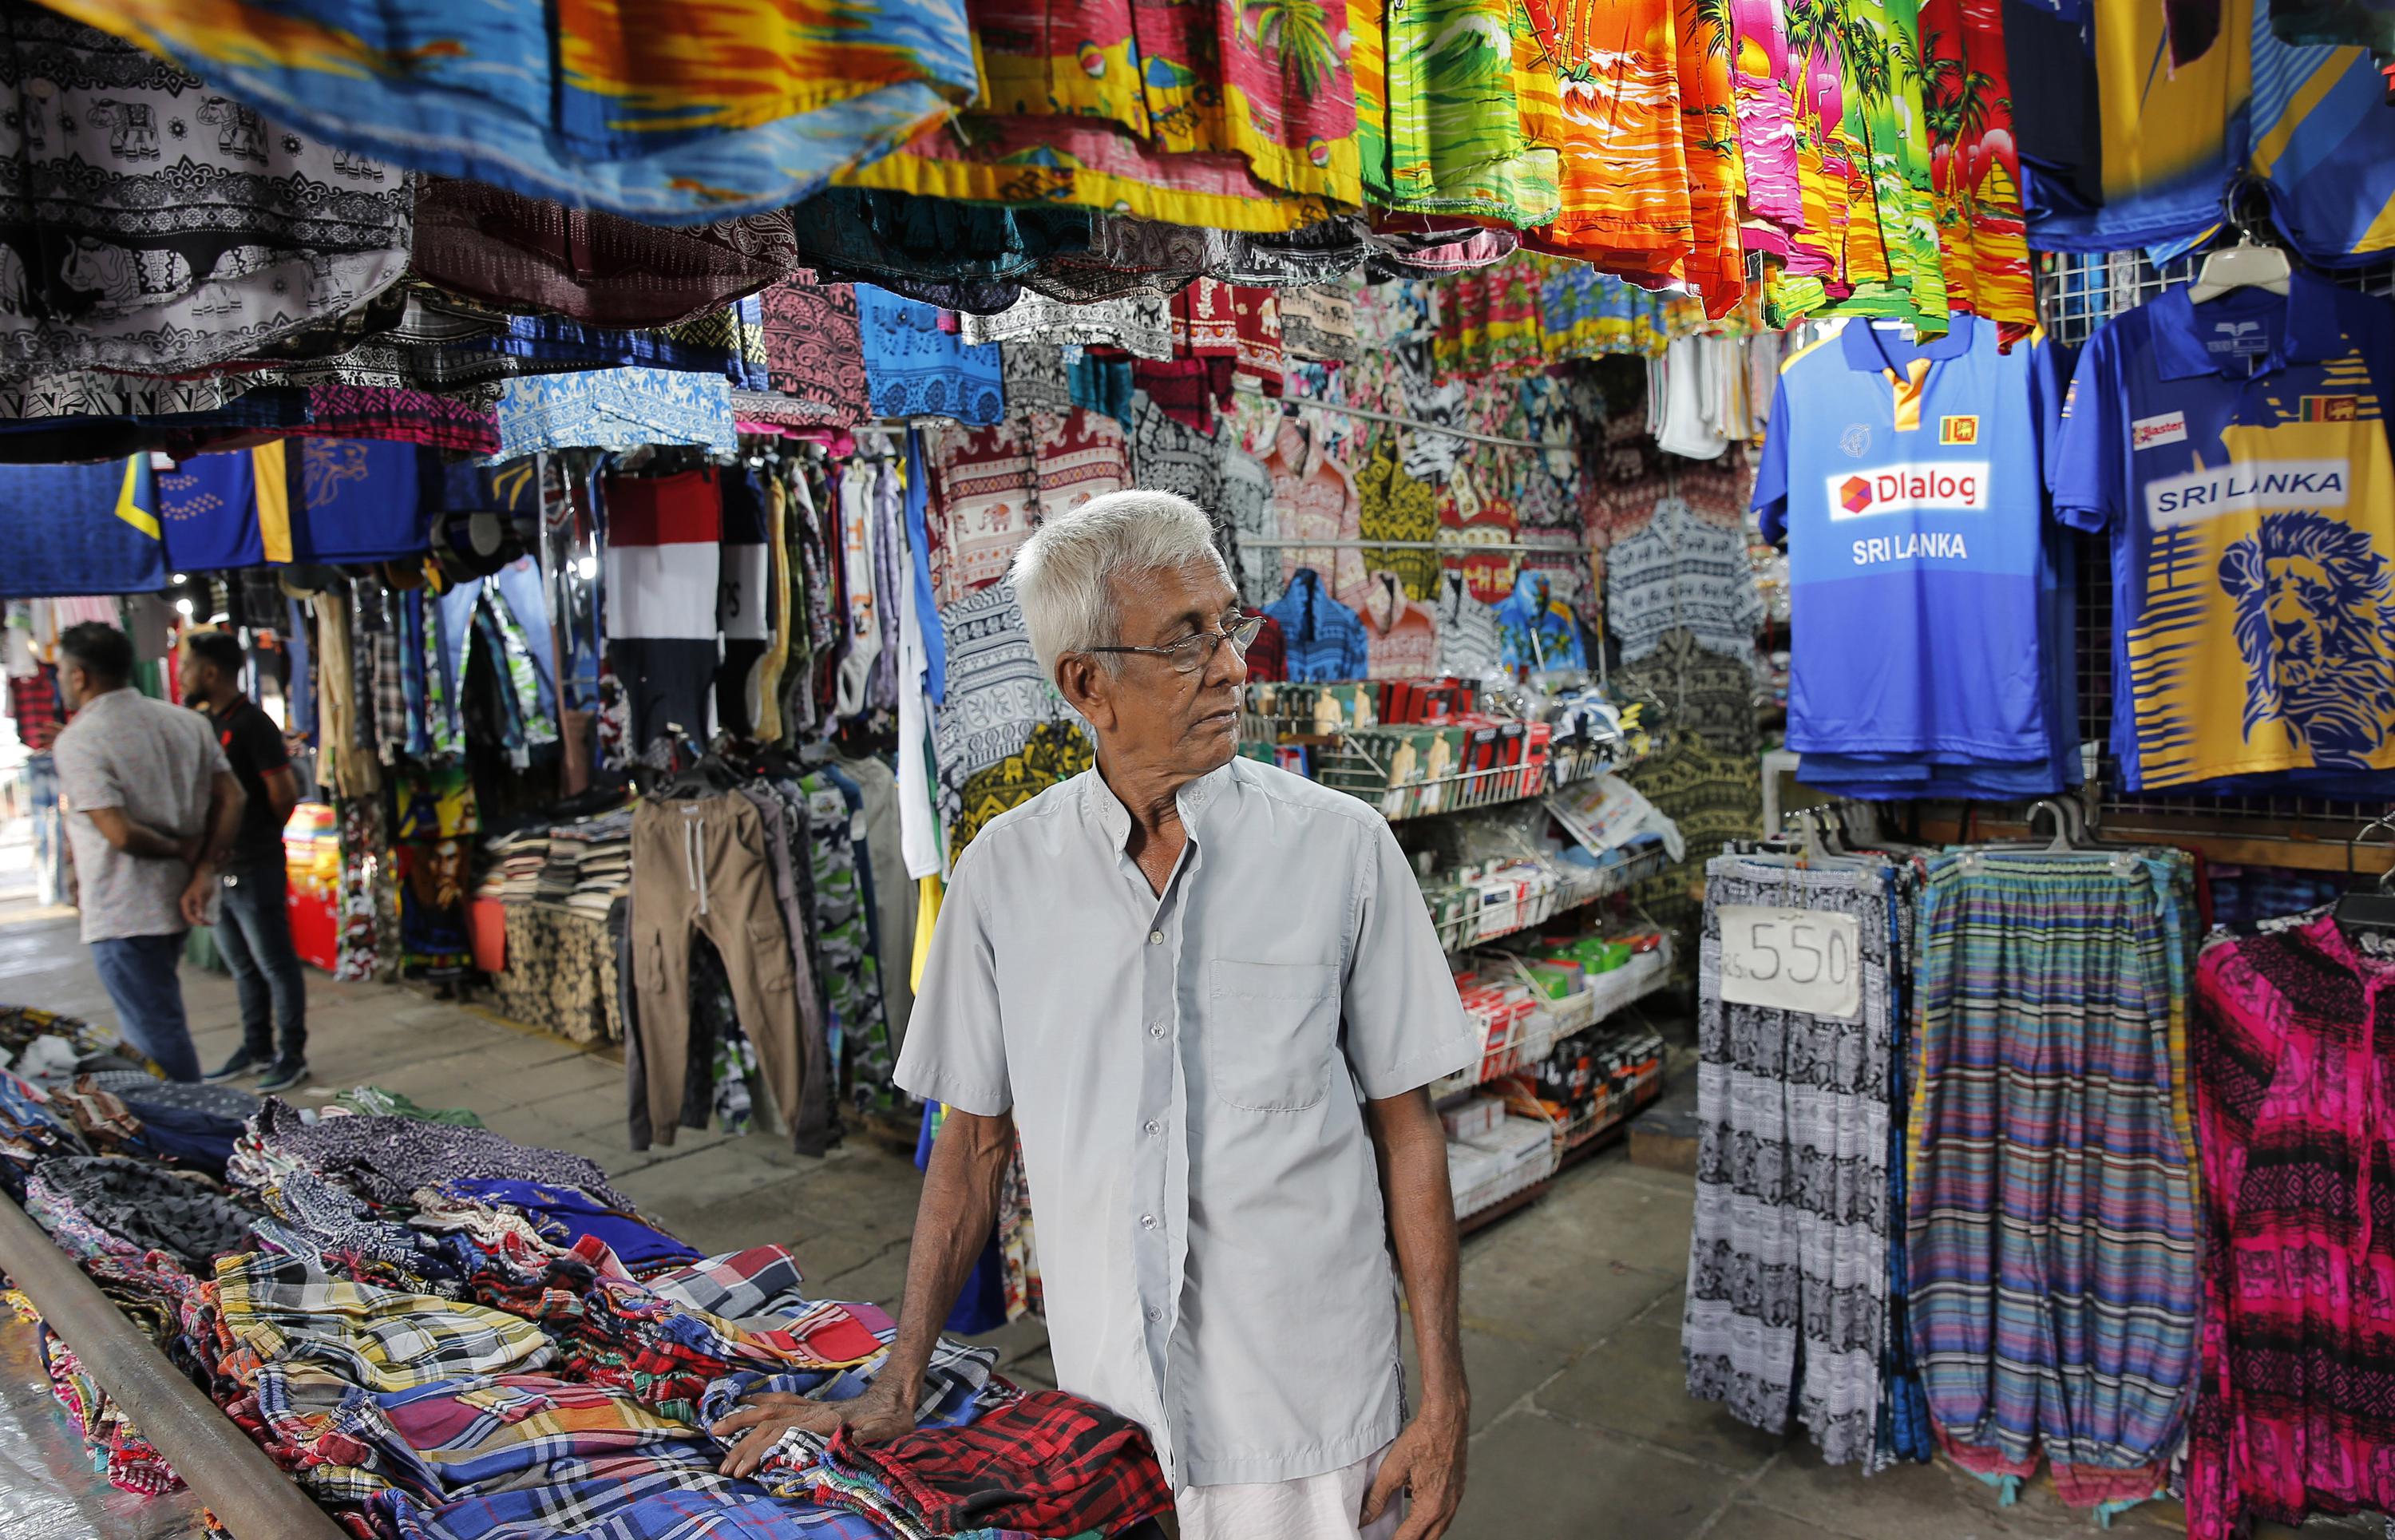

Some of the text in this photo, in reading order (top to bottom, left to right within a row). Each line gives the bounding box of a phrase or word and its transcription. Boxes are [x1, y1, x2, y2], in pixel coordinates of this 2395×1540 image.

[2158, 473, 2342, 512] SRI LANKA
[1852, 532, 1967, 565] SRI LANKA
